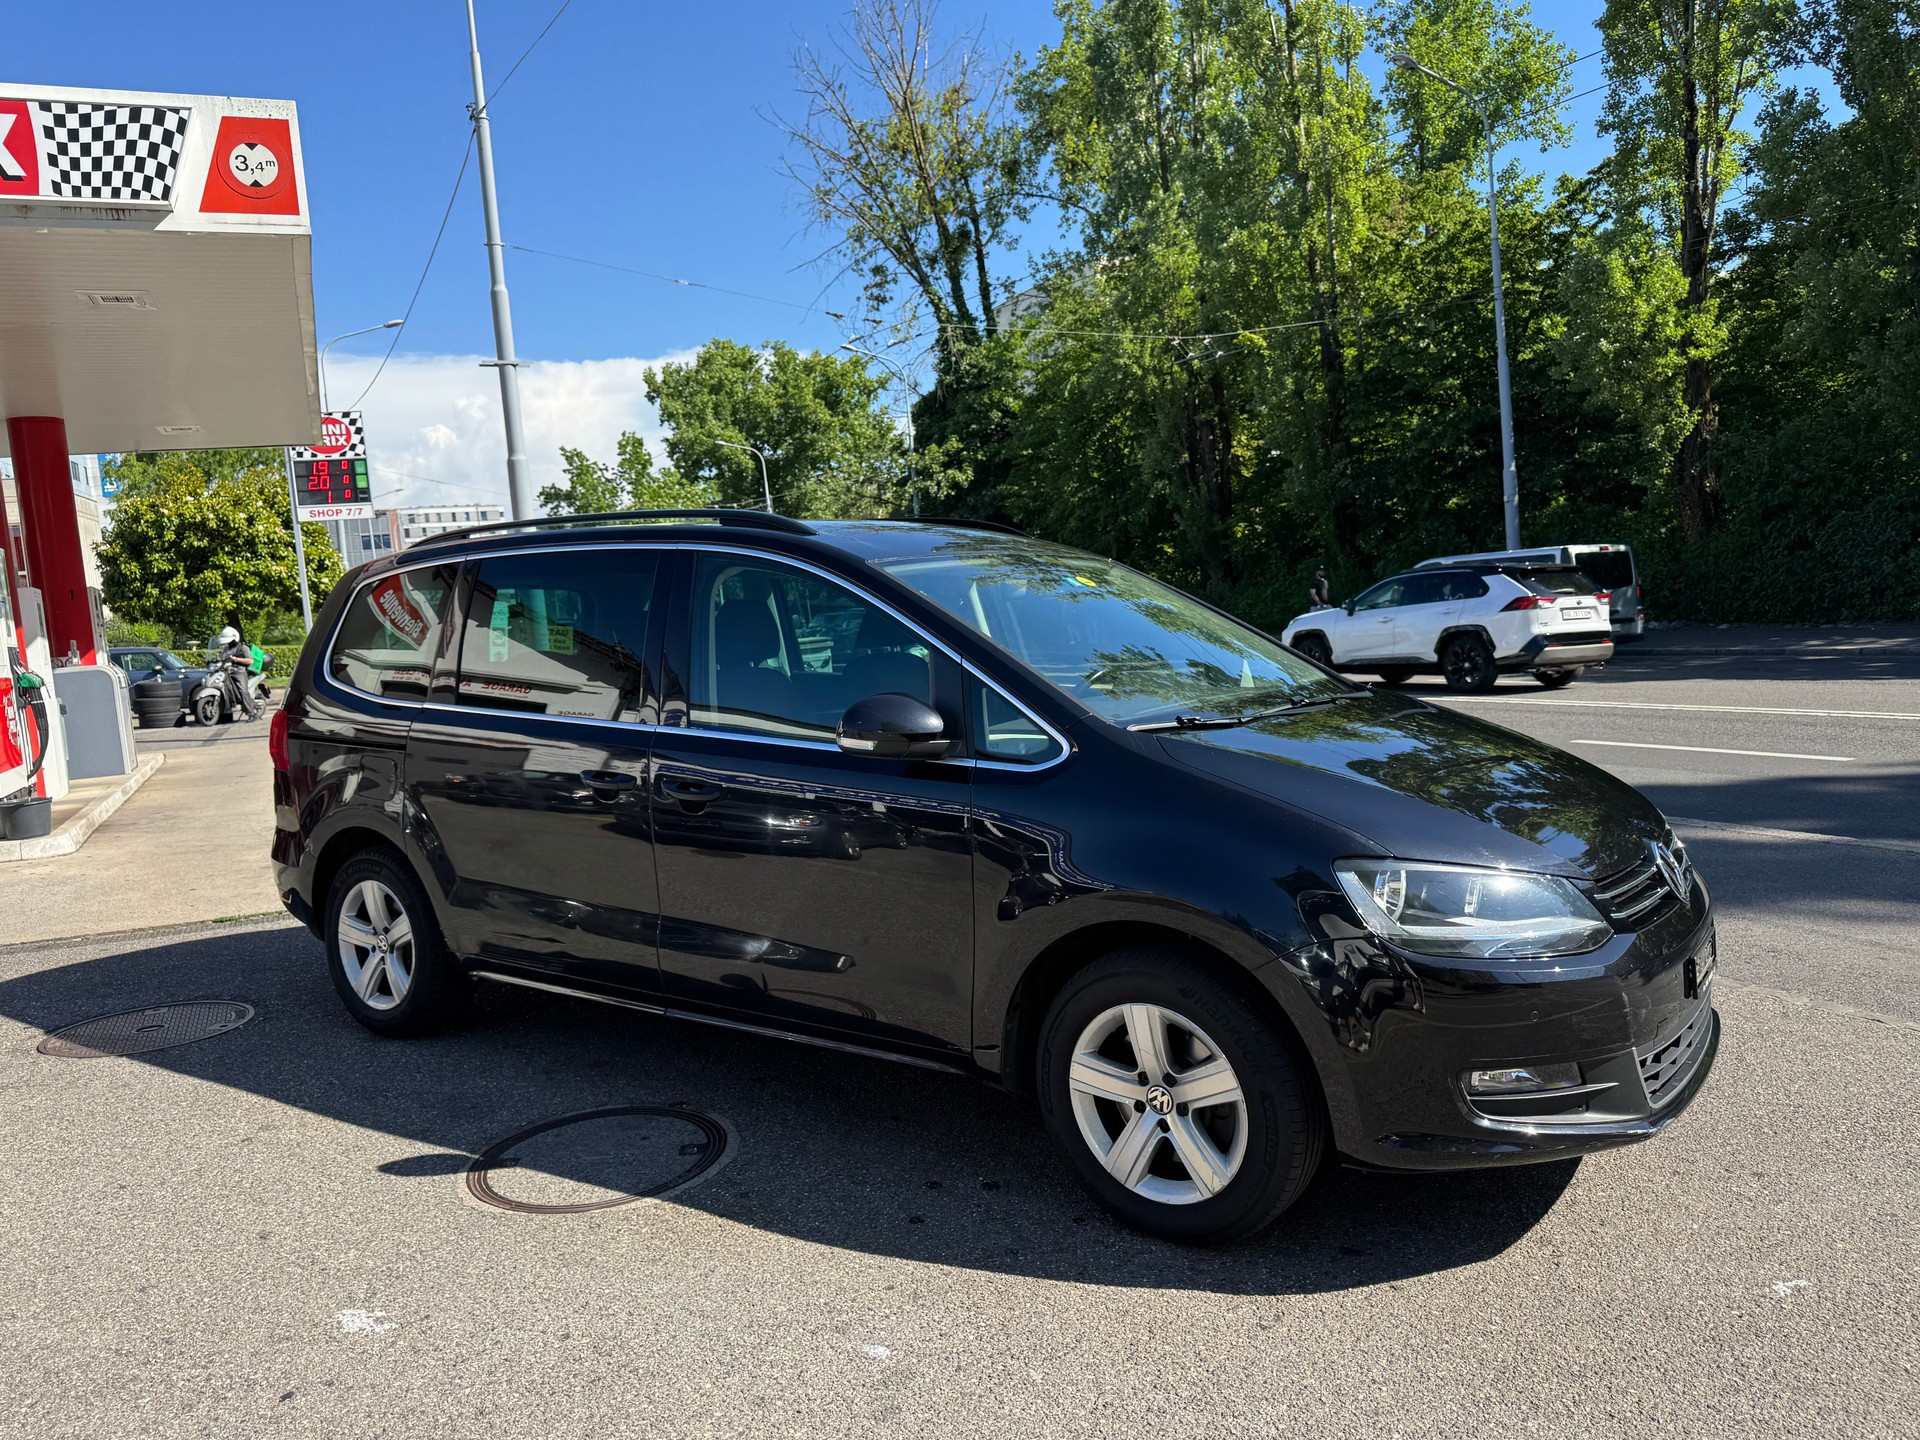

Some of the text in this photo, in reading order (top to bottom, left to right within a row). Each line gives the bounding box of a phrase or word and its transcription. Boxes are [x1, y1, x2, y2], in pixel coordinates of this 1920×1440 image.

[321, 424, 347, 435] INI
[322, 435, 349, 446] RIX
[309, 507, 363, 518] SHOP 7/7
[67, 588, 75, 601] 1
